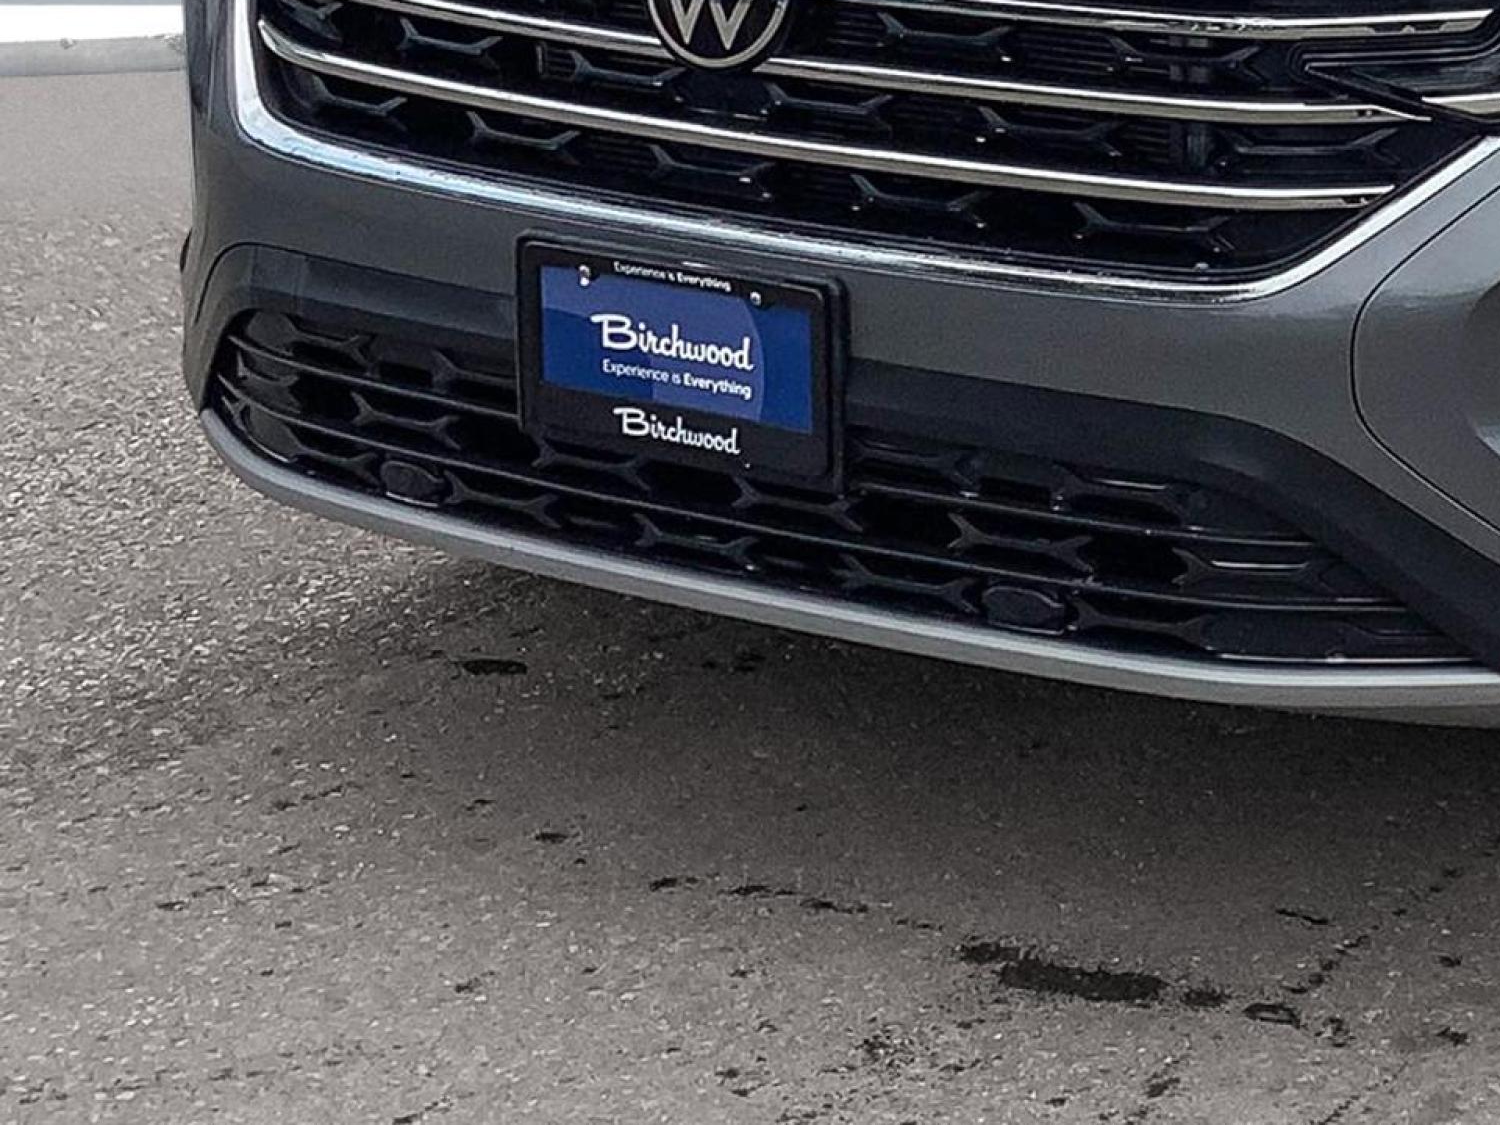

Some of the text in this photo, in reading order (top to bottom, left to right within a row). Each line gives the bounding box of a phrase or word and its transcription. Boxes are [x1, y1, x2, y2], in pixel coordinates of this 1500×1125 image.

[590, 313, 753, 371] Birchwood
[602, 358, 752, 400] Experience is Everything
[613, 407, 740, 455] Birchwood
